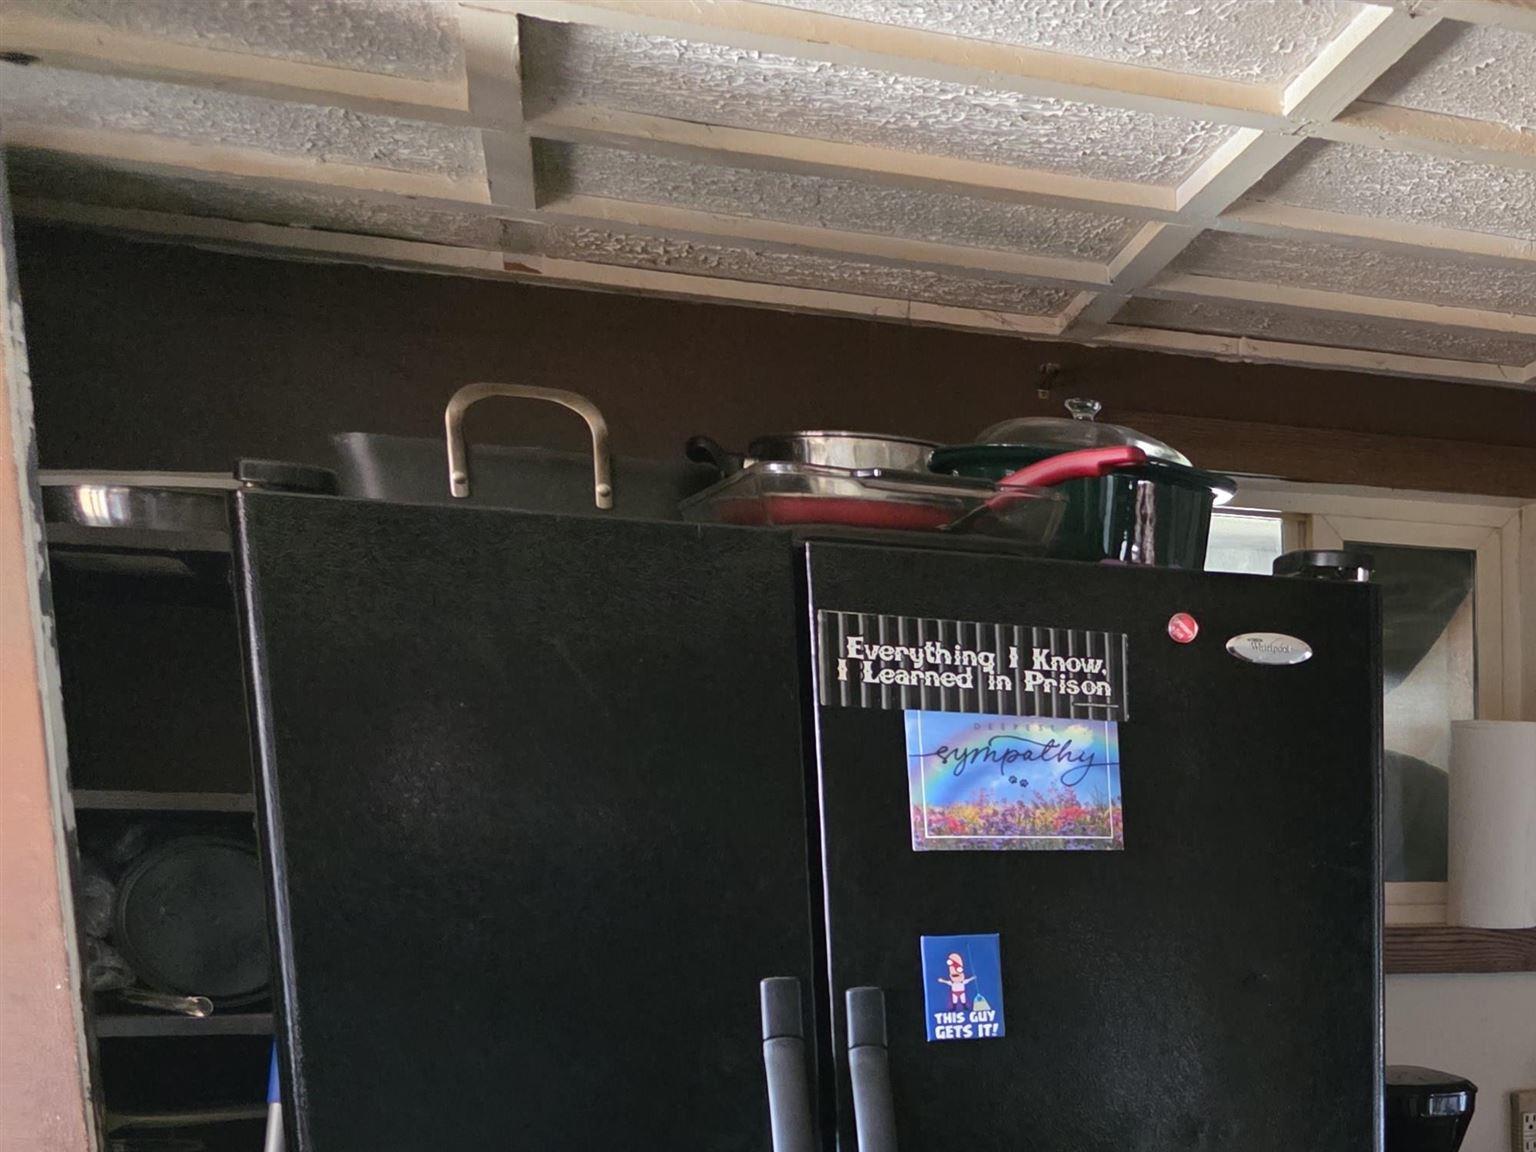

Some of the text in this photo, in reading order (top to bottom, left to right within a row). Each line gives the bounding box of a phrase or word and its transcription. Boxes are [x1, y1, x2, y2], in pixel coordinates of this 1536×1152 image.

[846, 636, 1108, 676] Everything I Know,
[837, 658, 1112, 697] I Learned in Prison
[914, 735, 1116, 786] sympathy
[934, 1010, 996, 1024] THIS GUY
[935, 1023, 999, 1039] GETS IT!
